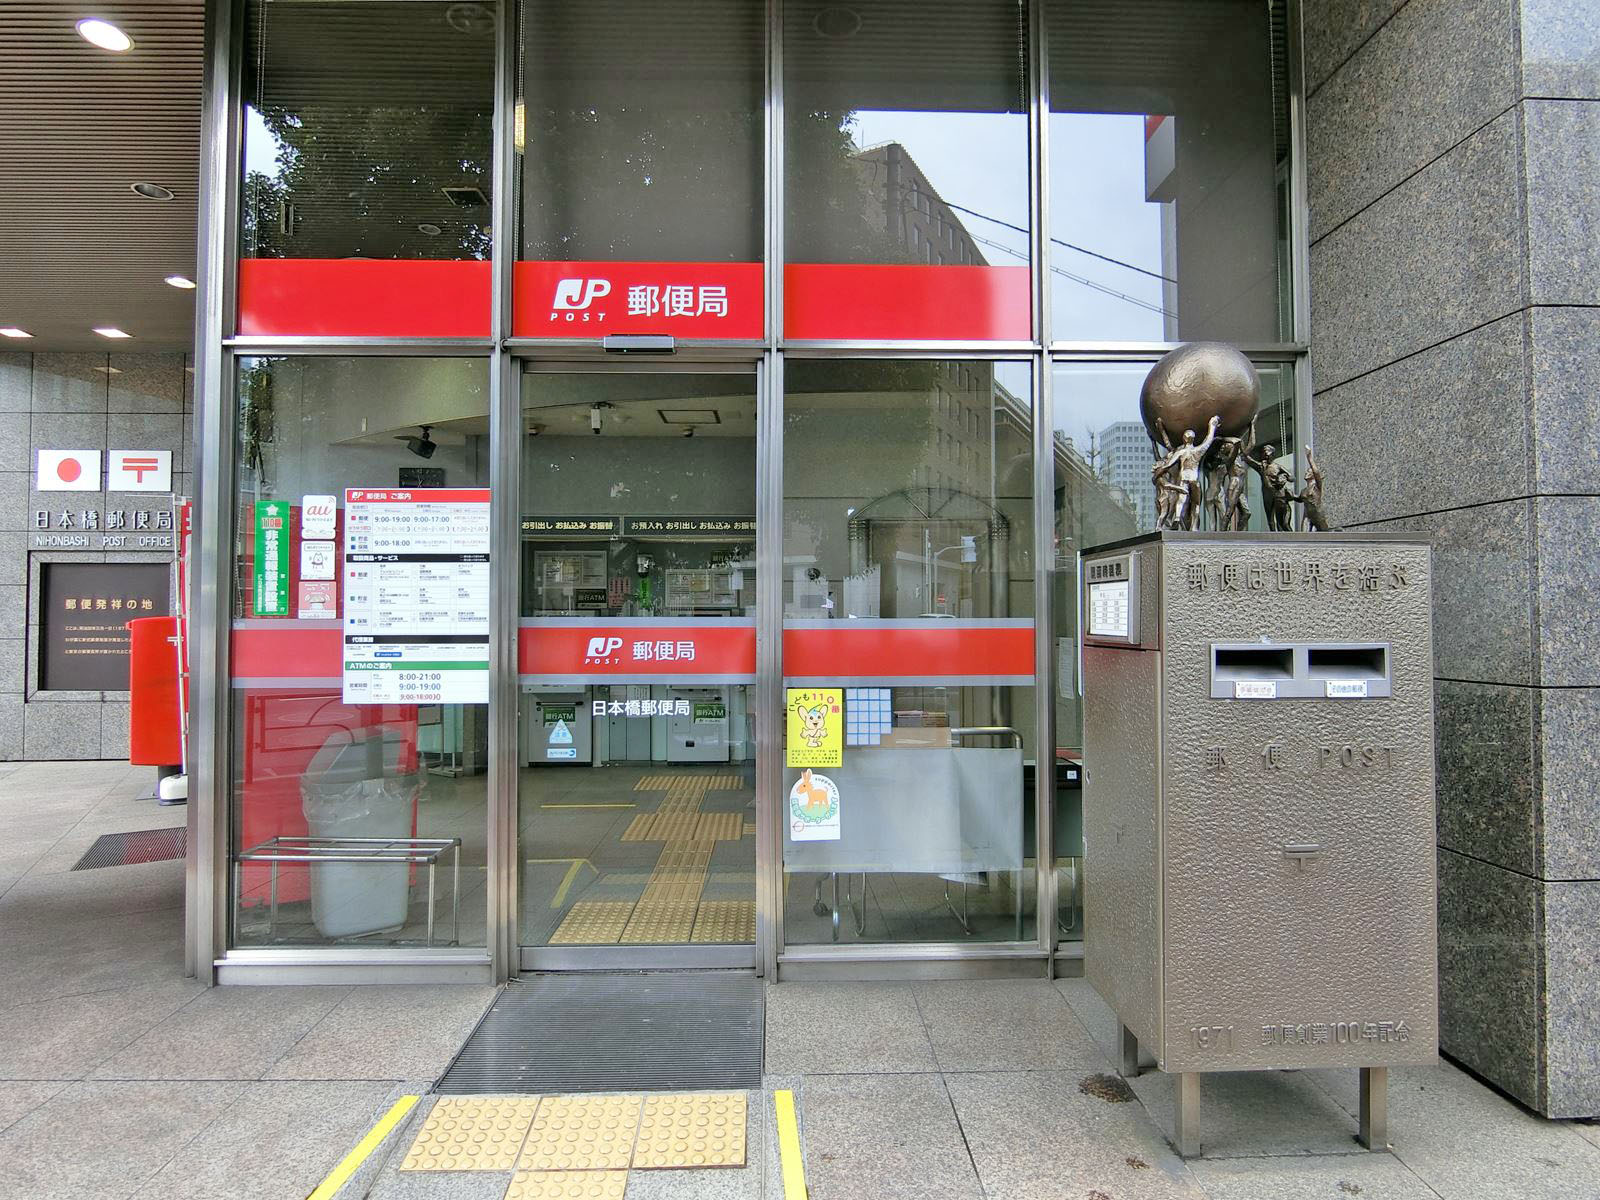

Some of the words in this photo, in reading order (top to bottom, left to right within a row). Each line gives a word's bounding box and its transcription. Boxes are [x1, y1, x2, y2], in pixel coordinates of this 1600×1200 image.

[553, 279, 611, 310] JP
[628, 286, 728, 317] 郵便局
[550, 313, 606, 322] POST
[366, 492, 387, 500] 郵便局
[390, 492, 412, 500] ご案内
[36, 510, 173, 529] 日本橋郵便局
[307, 505, 332, 516] au
[522, 521, 552, 530] お引出し
[555, 521, 586, 530] お払込み
[589, 521, 613, 530] お振替
[631, 522, 664, 530] お預入れ
[666, 522, 697, 530] お引出し
[699, 522, 731, 530] お払込み
[36, 536, 90, 546] NIHONBASHI
[103, 536, 126, 546] POST
[139, 536, 172, 546] OFFICE
[1187, 560, 1408, 592] 郵便は世界を結ぶ
[65, 599, 153, 610] 郵便発祥の地
[586, 637, 624, 657] JP
[632, 640, 695, 661] 郵便局
[349, 662, 392, 670] ATMのご案内
[592, 700, 690, 717] 日本橋郵便局
[1319, 746, 1394, 769] POST
[1190, 1025, 1234, 1049] 1971
[1261, 1020, 1412, 1046] 郵便創業100年記念
